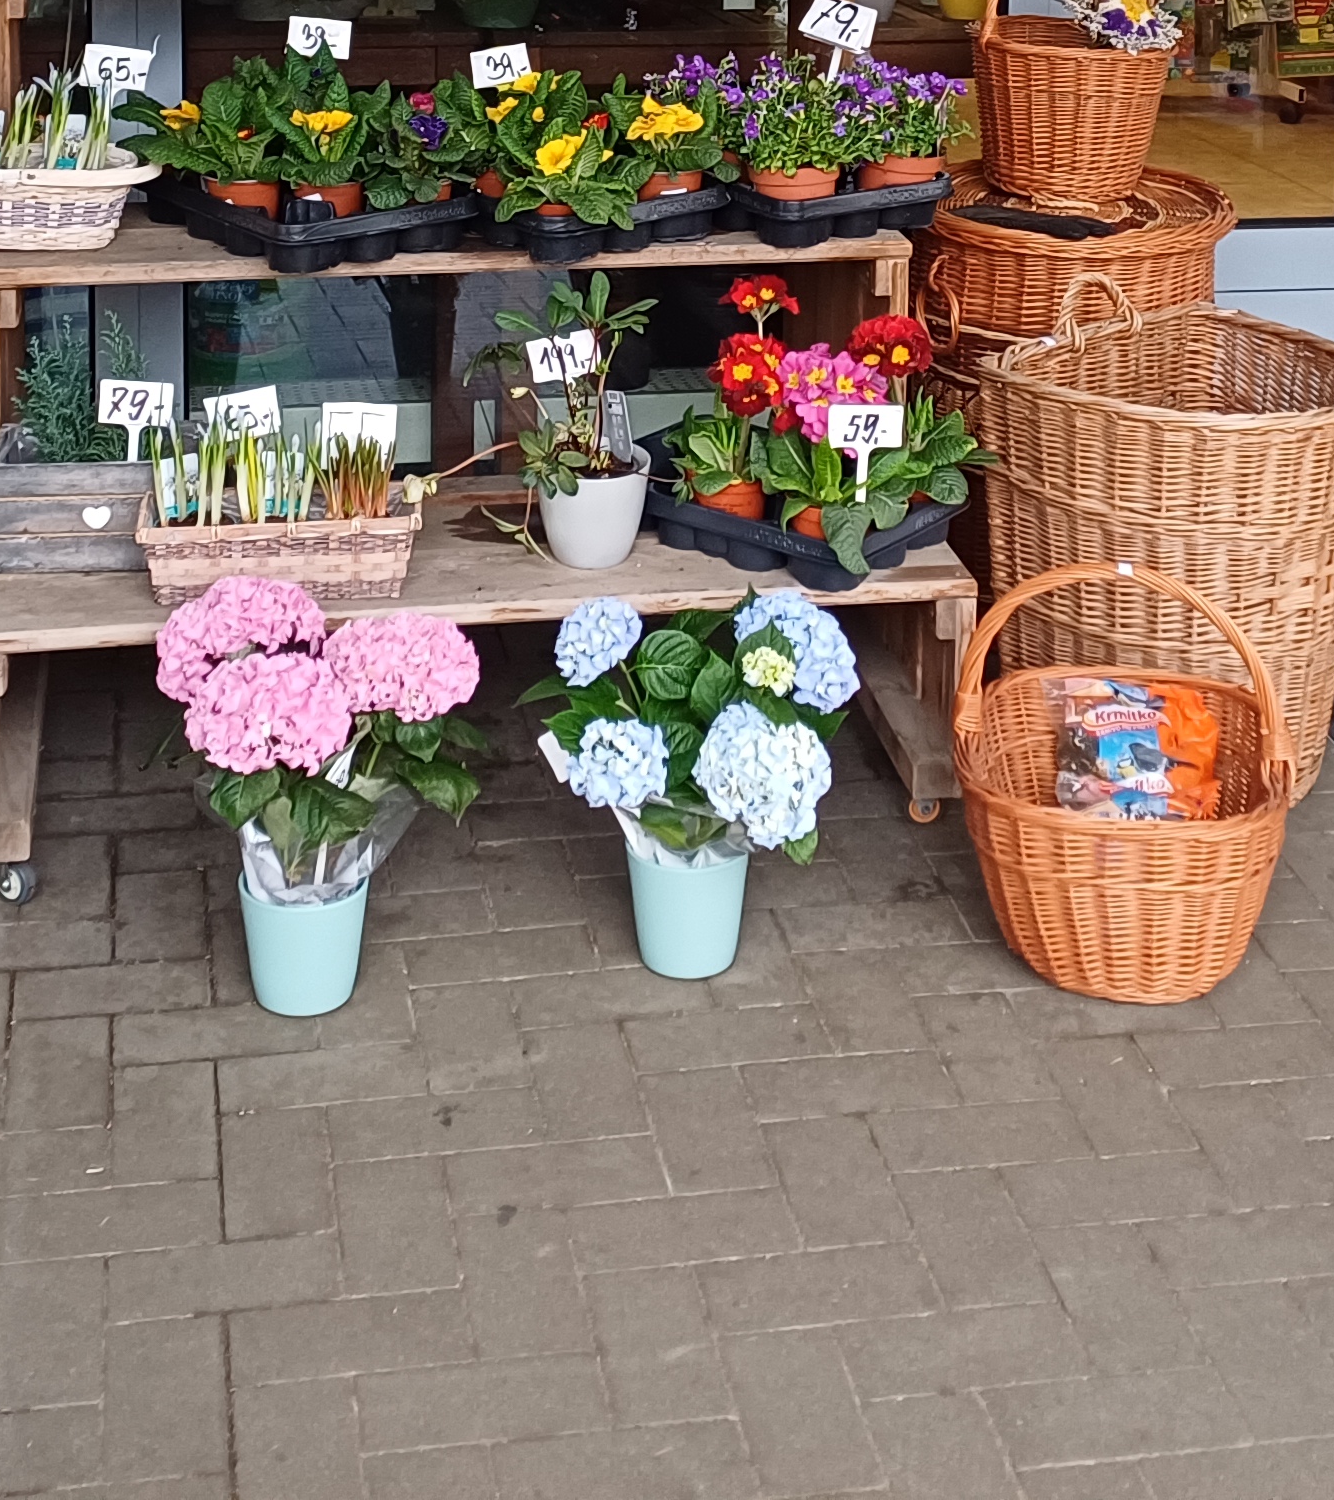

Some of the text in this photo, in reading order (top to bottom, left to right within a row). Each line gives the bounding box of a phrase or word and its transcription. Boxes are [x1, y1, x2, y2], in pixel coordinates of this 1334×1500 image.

[98, 56, 147, 85] 65,-
[486, 52, 528, 80] 39,-
[843, 414, 887, 445] 59,-
